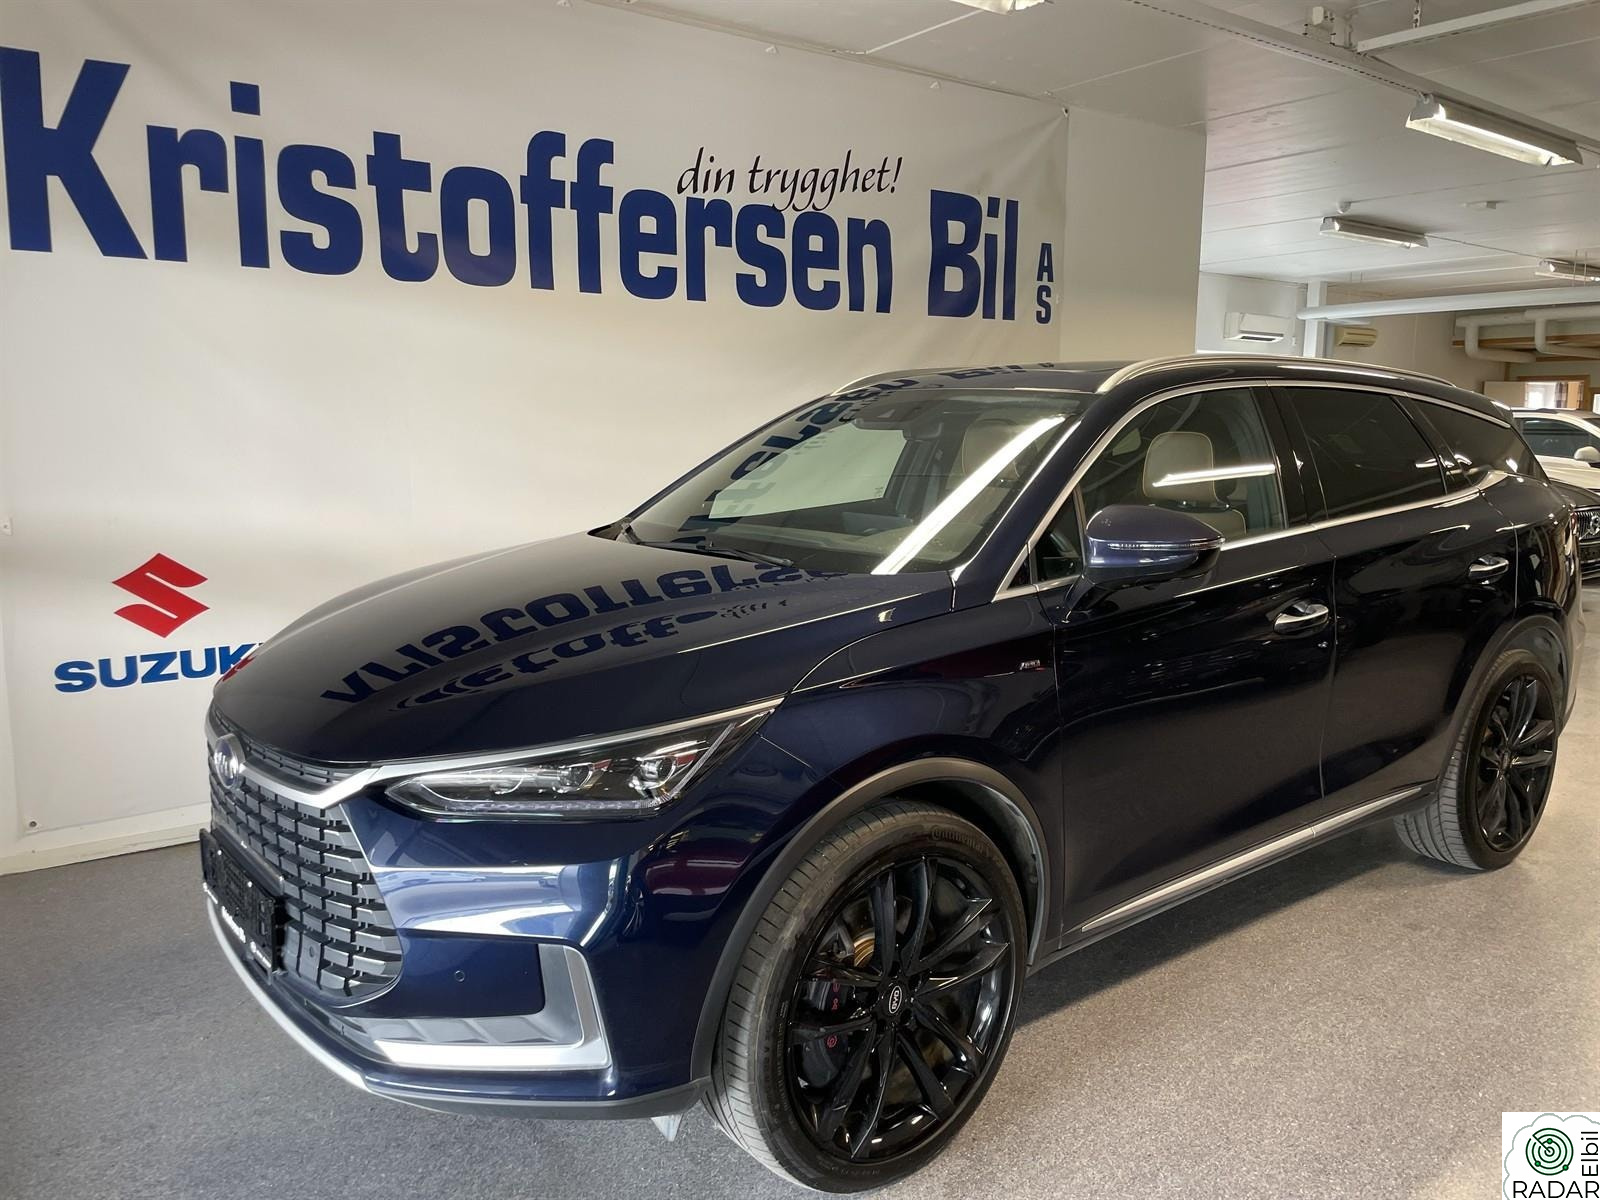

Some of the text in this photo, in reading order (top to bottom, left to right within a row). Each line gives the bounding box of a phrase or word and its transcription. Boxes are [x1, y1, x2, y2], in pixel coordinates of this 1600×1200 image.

[0, 46, 893, 314] Kristoffersen
[927, 189, 1019, 321] Bil
[676, 146, 903, 212] din trygghet!
[54, 642, 264, 693] SUZUK
